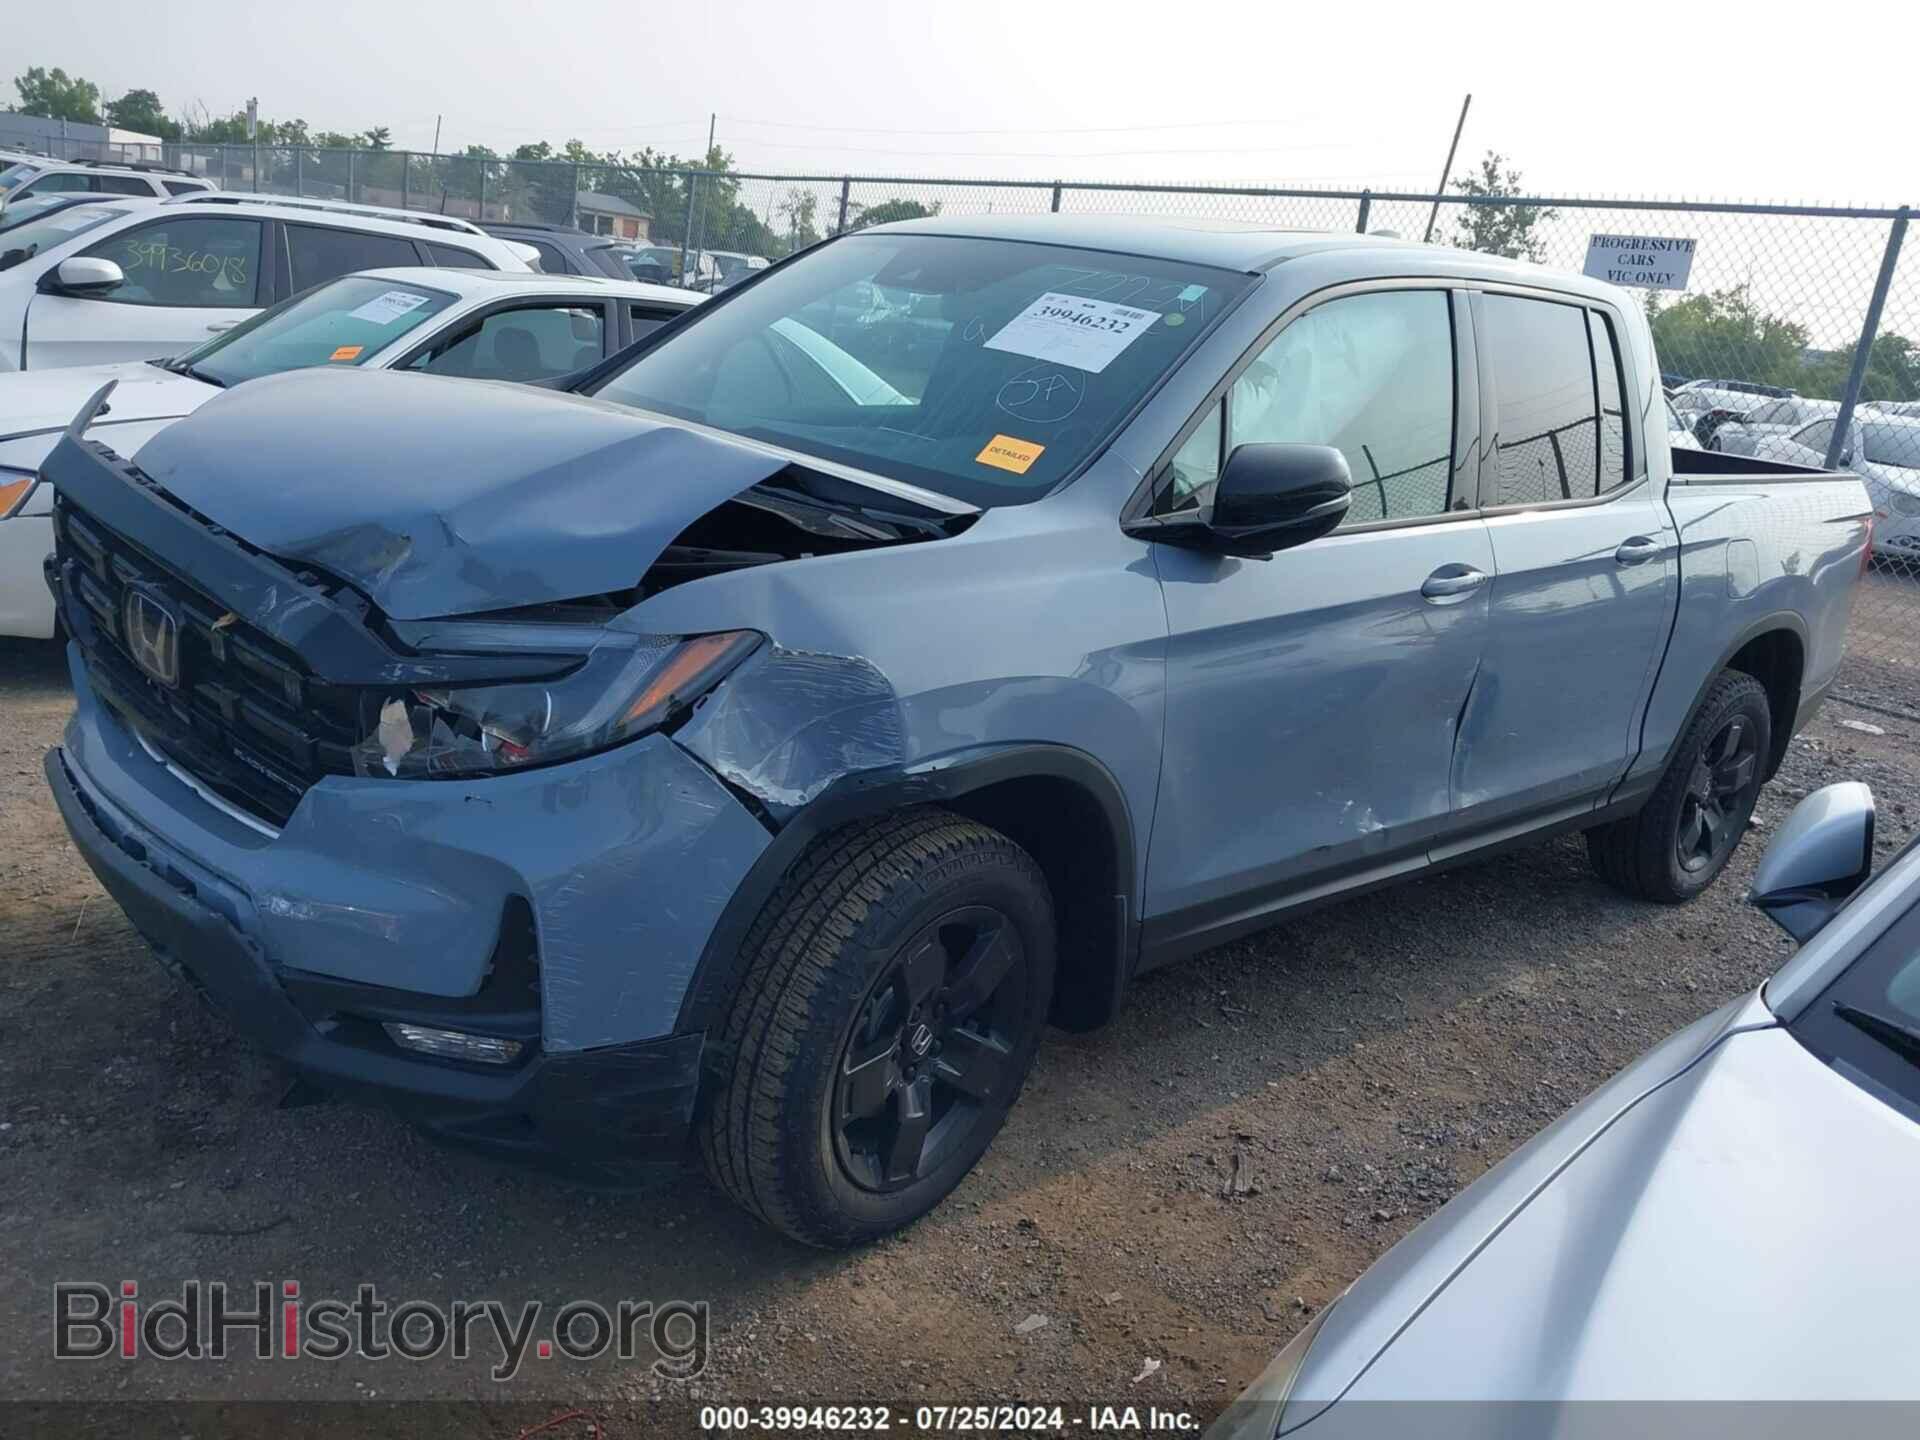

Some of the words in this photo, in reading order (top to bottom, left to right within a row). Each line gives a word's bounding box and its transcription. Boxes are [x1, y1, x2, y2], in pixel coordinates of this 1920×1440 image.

[1592, 235, 1693, 253] PROGRESSIVE
[124, 239, 247, 284] 39936018
[1617, 253, 1656, 267] CARS
[1607, 269, 1632, 282] VIC
[1635, 271, 1674, 285] ONLY
[1033, 305, 1130, 334] 39946232
[989, 446, 1030, 461] DETAILED
